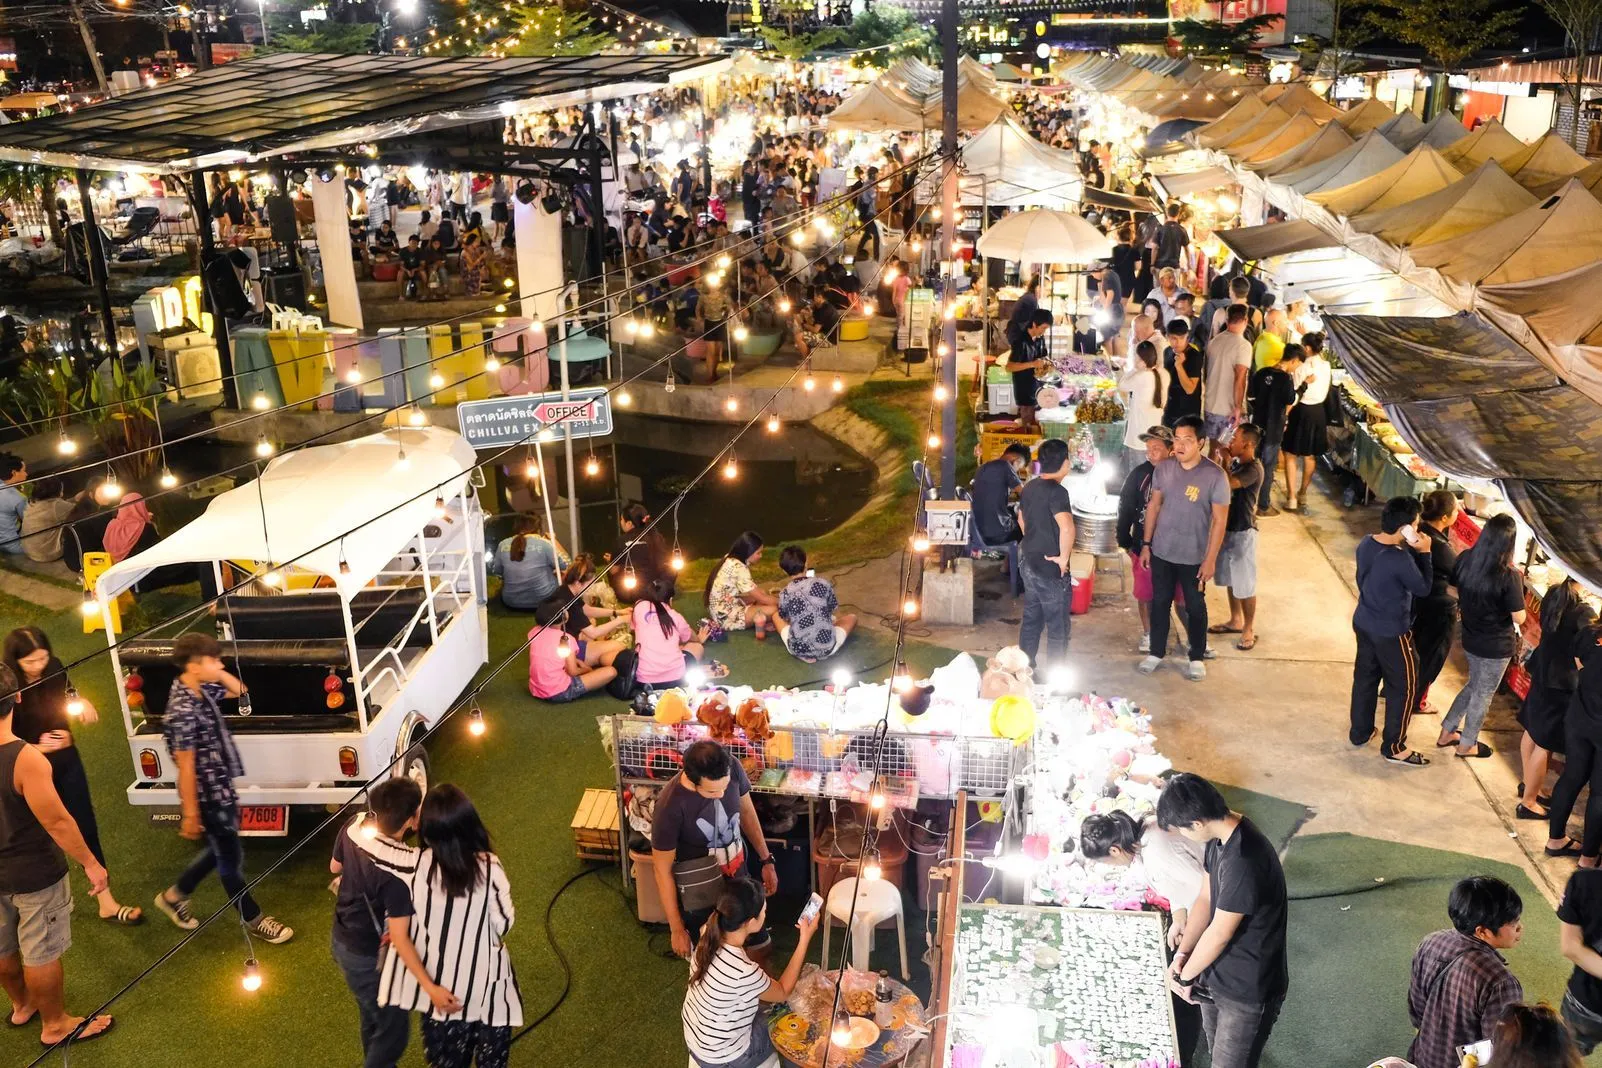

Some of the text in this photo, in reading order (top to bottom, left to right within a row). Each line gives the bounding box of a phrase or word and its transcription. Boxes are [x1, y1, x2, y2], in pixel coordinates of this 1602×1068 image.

[547, 407, 587, 418] OFFICE
[468, 425, 519, 439] CHILLVA
[240, 807, 278, 823] -7608
